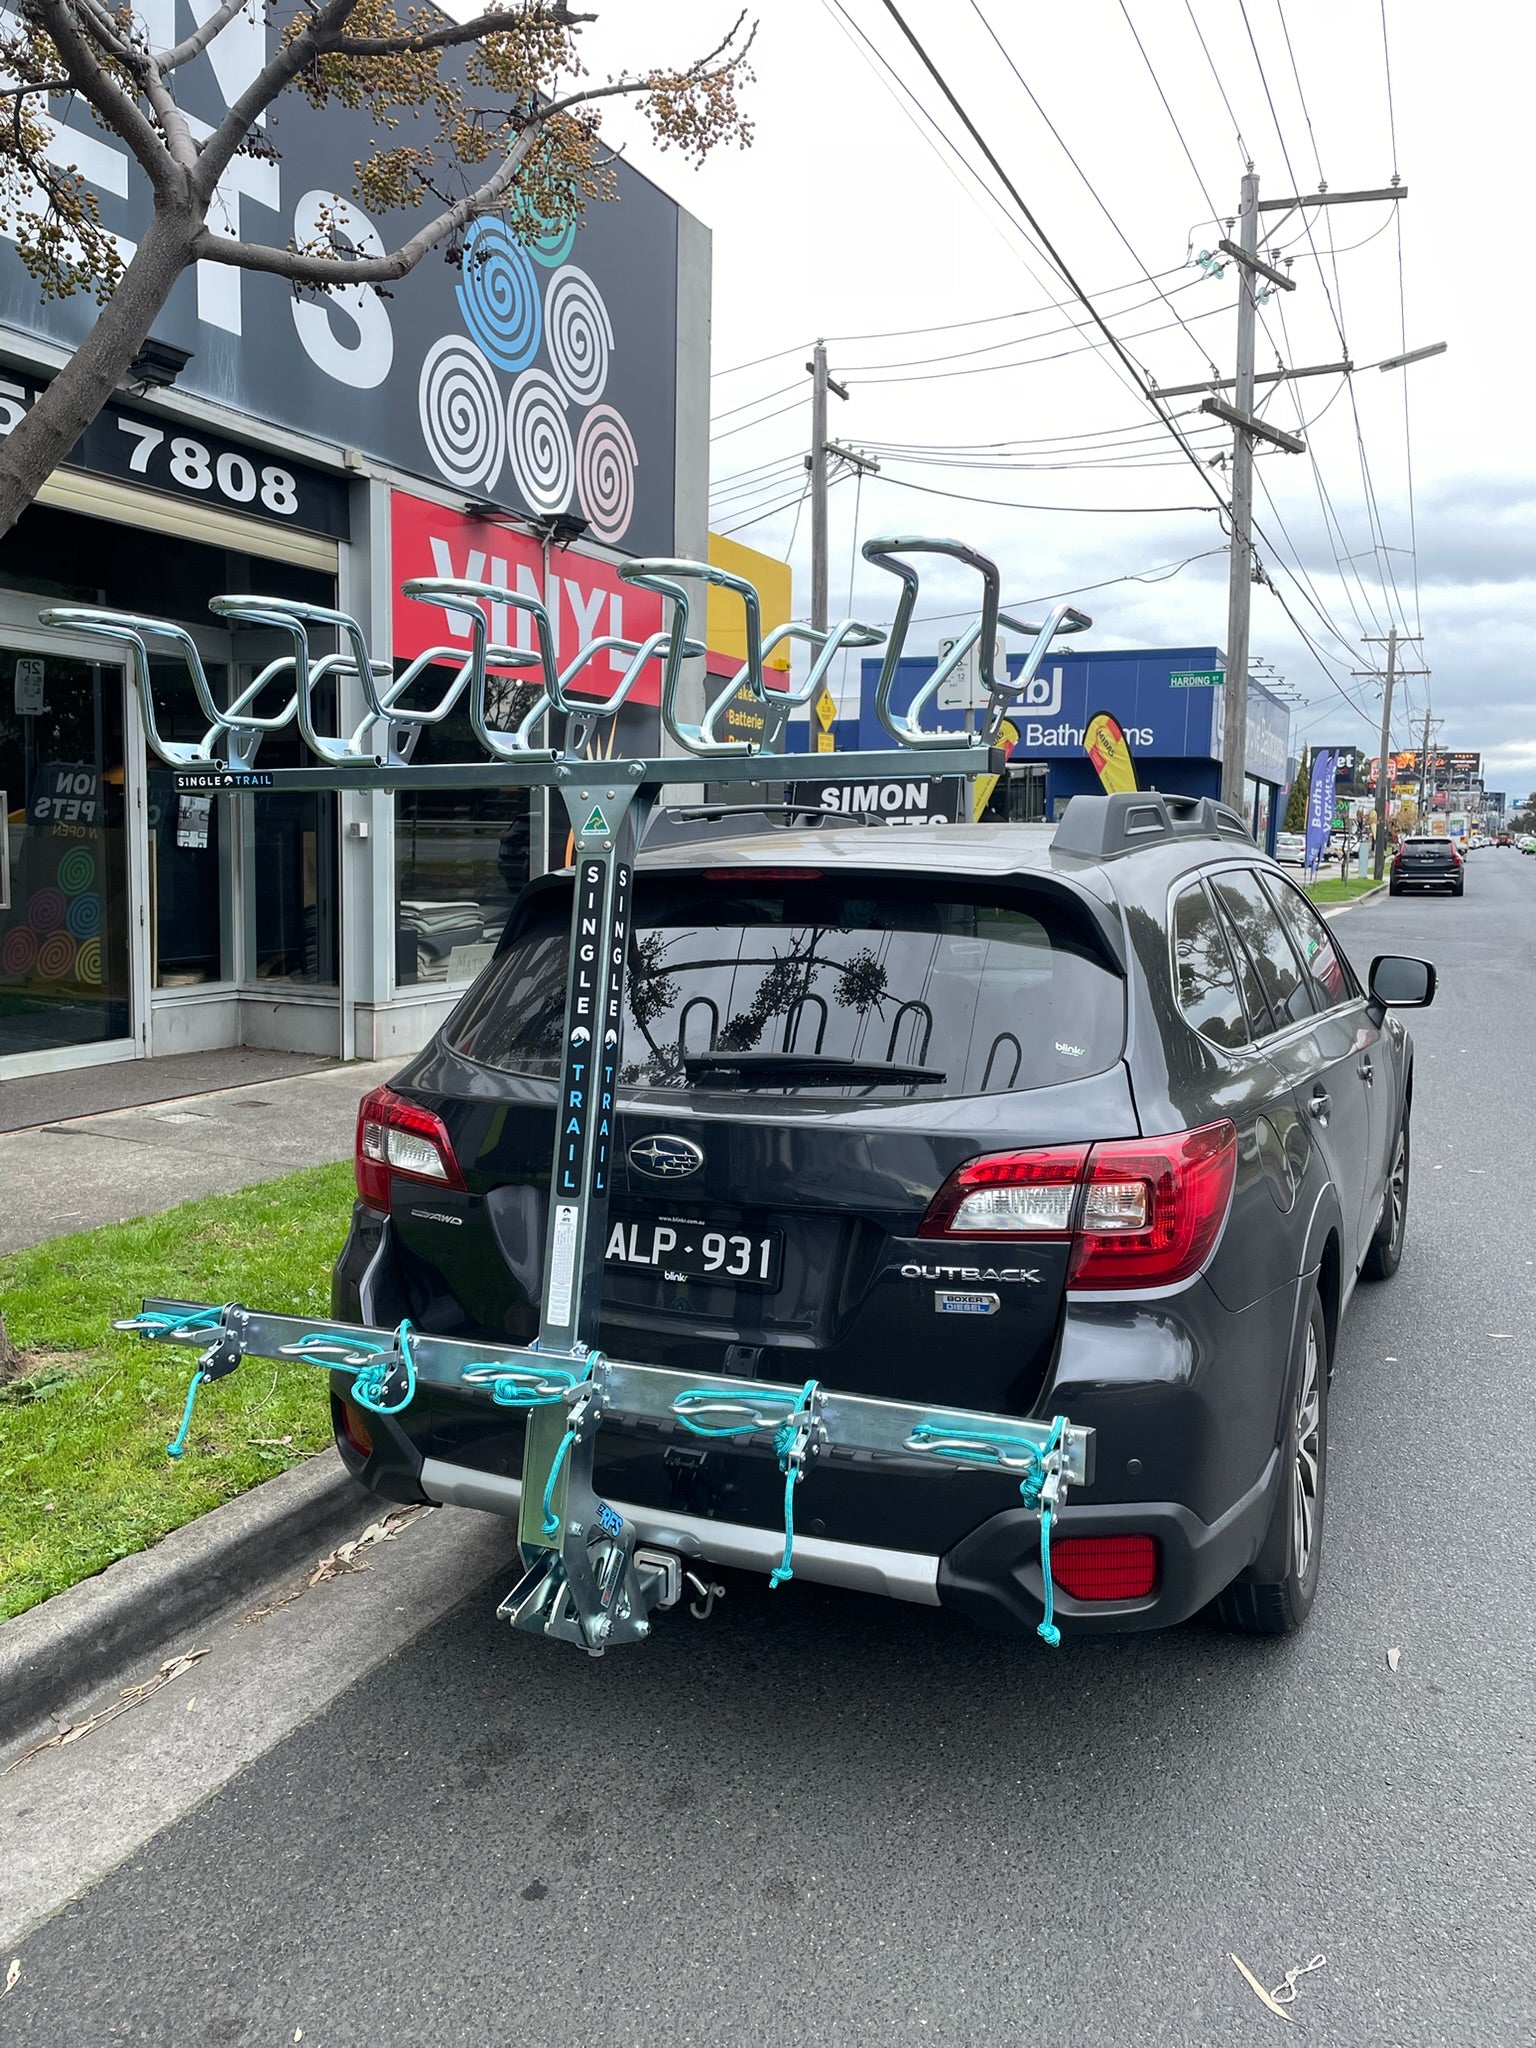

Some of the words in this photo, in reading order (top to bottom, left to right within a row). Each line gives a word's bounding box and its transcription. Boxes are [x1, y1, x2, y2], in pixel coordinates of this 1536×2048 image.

[118, 417, 299, 515] 7808
[429, 536, 637, 674] VINYL
[1170, 676, 1210, 686] HARDING
[729, 708, 765, 730] Batterie
[1027, 725, 1153, 747] Bathrms
[178, 776, 221, 787] SINGLE
[235, 775, 272, 785] TRAIL
[820, 782, 928, 812] SIMON
[1311, 780, 1323, 828] Baths
[577, 866, 600, 1014] SINGLE
[609, 869, 627, 1017] SINGLE
[1055, 1041, 1085, 1056] blinkr
[564, 1064, 585, 1188] TRAIL
[596, 1066, 613, 1189] TRAIL
[664, 1270, 689, 1283] blinkr
[900, 1264, 1041, 1283] OUTBACK
[946, 1295, 983, 1303] BOXER
[946, 1302, 985, 1312] DIESEL
[599, 1507, 624, 1537] RFS
